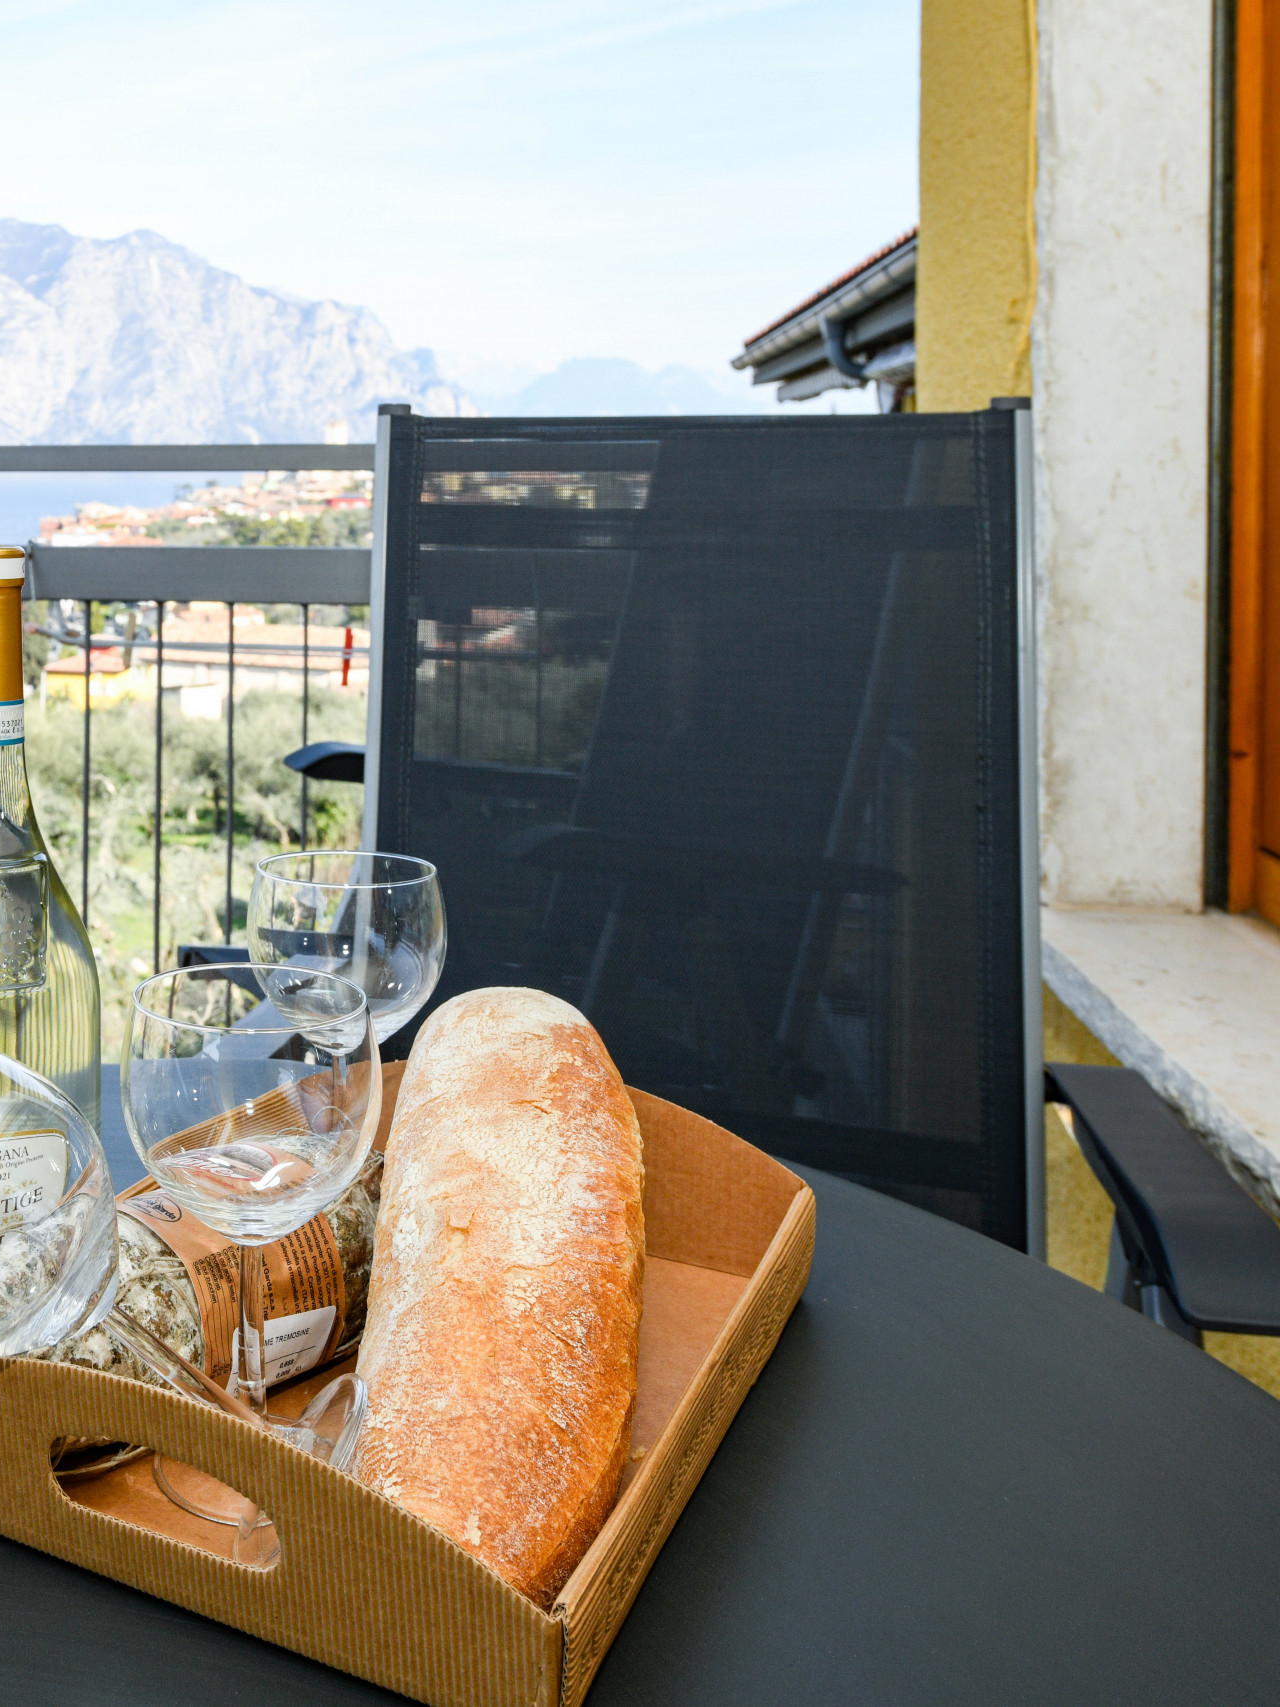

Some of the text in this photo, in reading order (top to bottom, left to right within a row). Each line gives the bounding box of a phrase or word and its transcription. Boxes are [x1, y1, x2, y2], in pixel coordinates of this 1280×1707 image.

[5, 1160, 25, 1169] Origine
[326, 1247, 335, 1269] Carne
[263, 1268, 273, 1292] Garda
[275, 1327, 311, 1344] TREMOSINE
